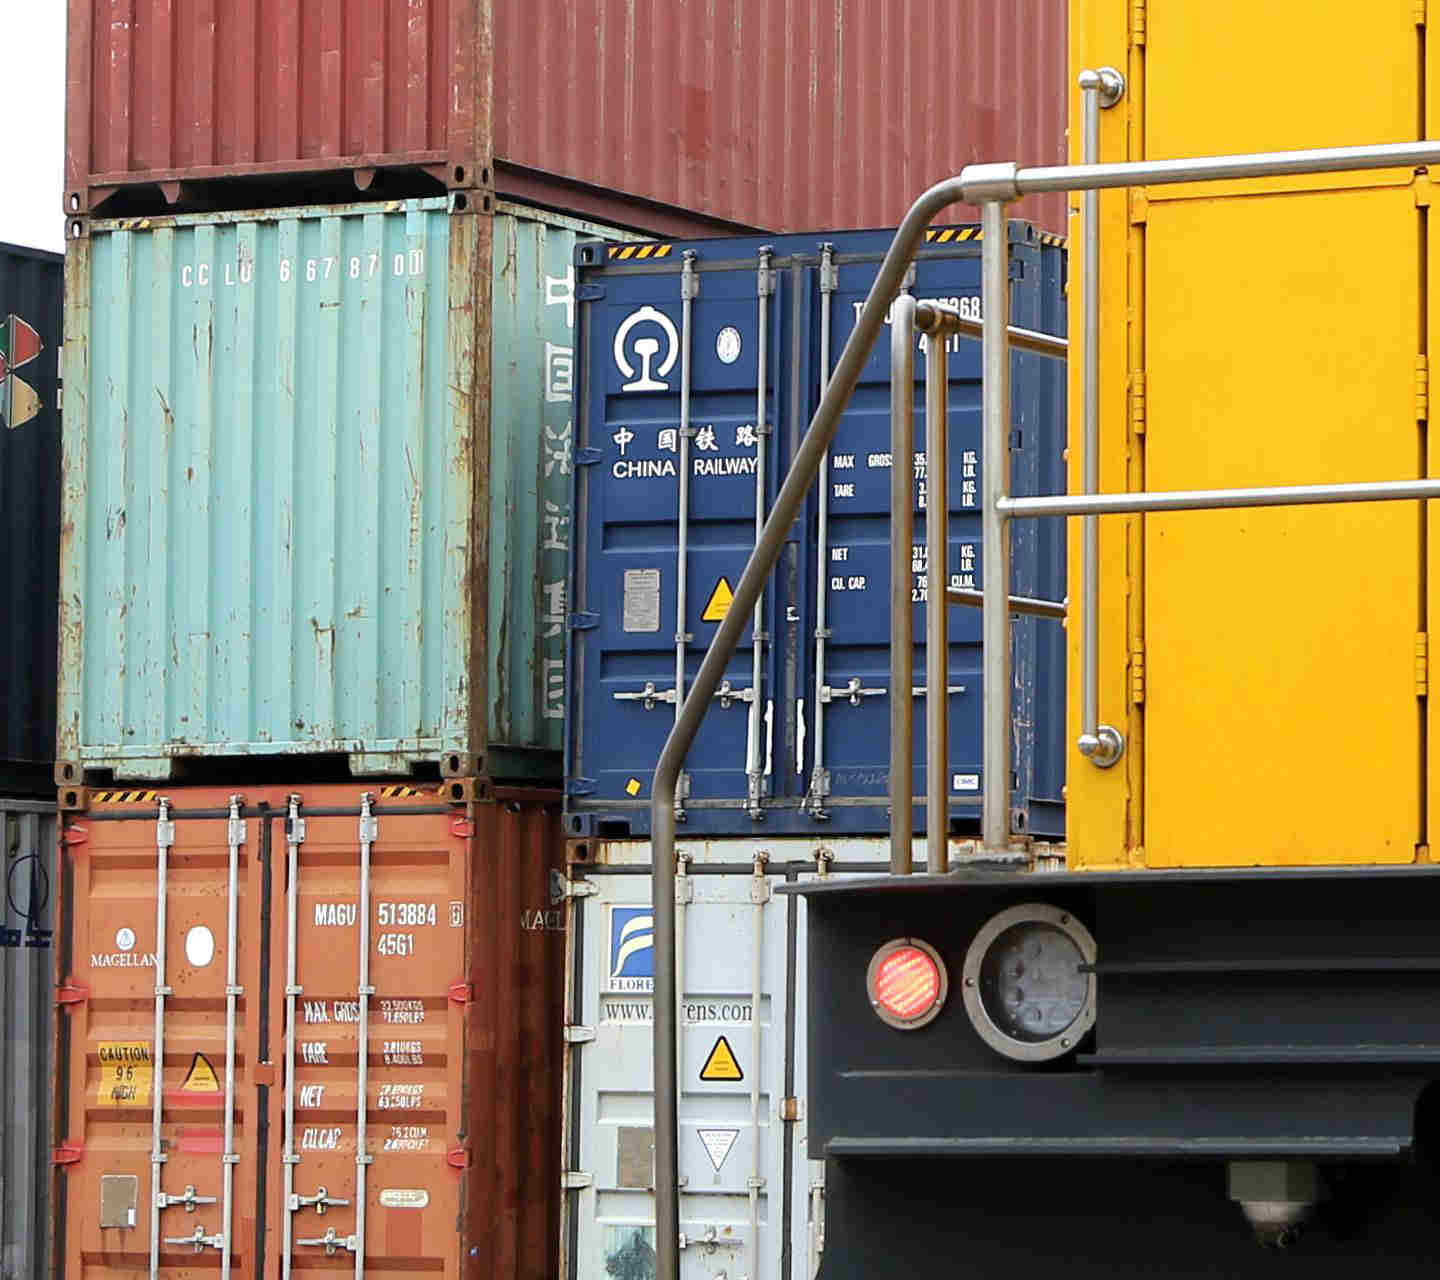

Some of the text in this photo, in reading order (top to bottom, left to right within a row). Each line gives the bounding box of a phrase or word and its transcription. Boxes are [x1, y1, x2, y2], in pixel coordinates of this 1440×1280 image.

[613, 424, 761, 457] 中国铁路
[612, 457, 759, 479] CHINA RAILWAY
[833, 454, 855, 469] MAX
[833, 483, 855, 498] TARE
[831, 547, 848, 562] NET
[314, 903, 357, 926] MAGU
[378, 903, 436, 926] 513884
[378, 933, 415, 956] 45G1
[90, 953, 159, 968] MAGELLAN
[609, 978, 655, 991] FLORE
[334, 1000, 361, 1023] GROS
[99, 1047, 149, 1062] CAUTION
[300, 1085, 325, 1108] NET
